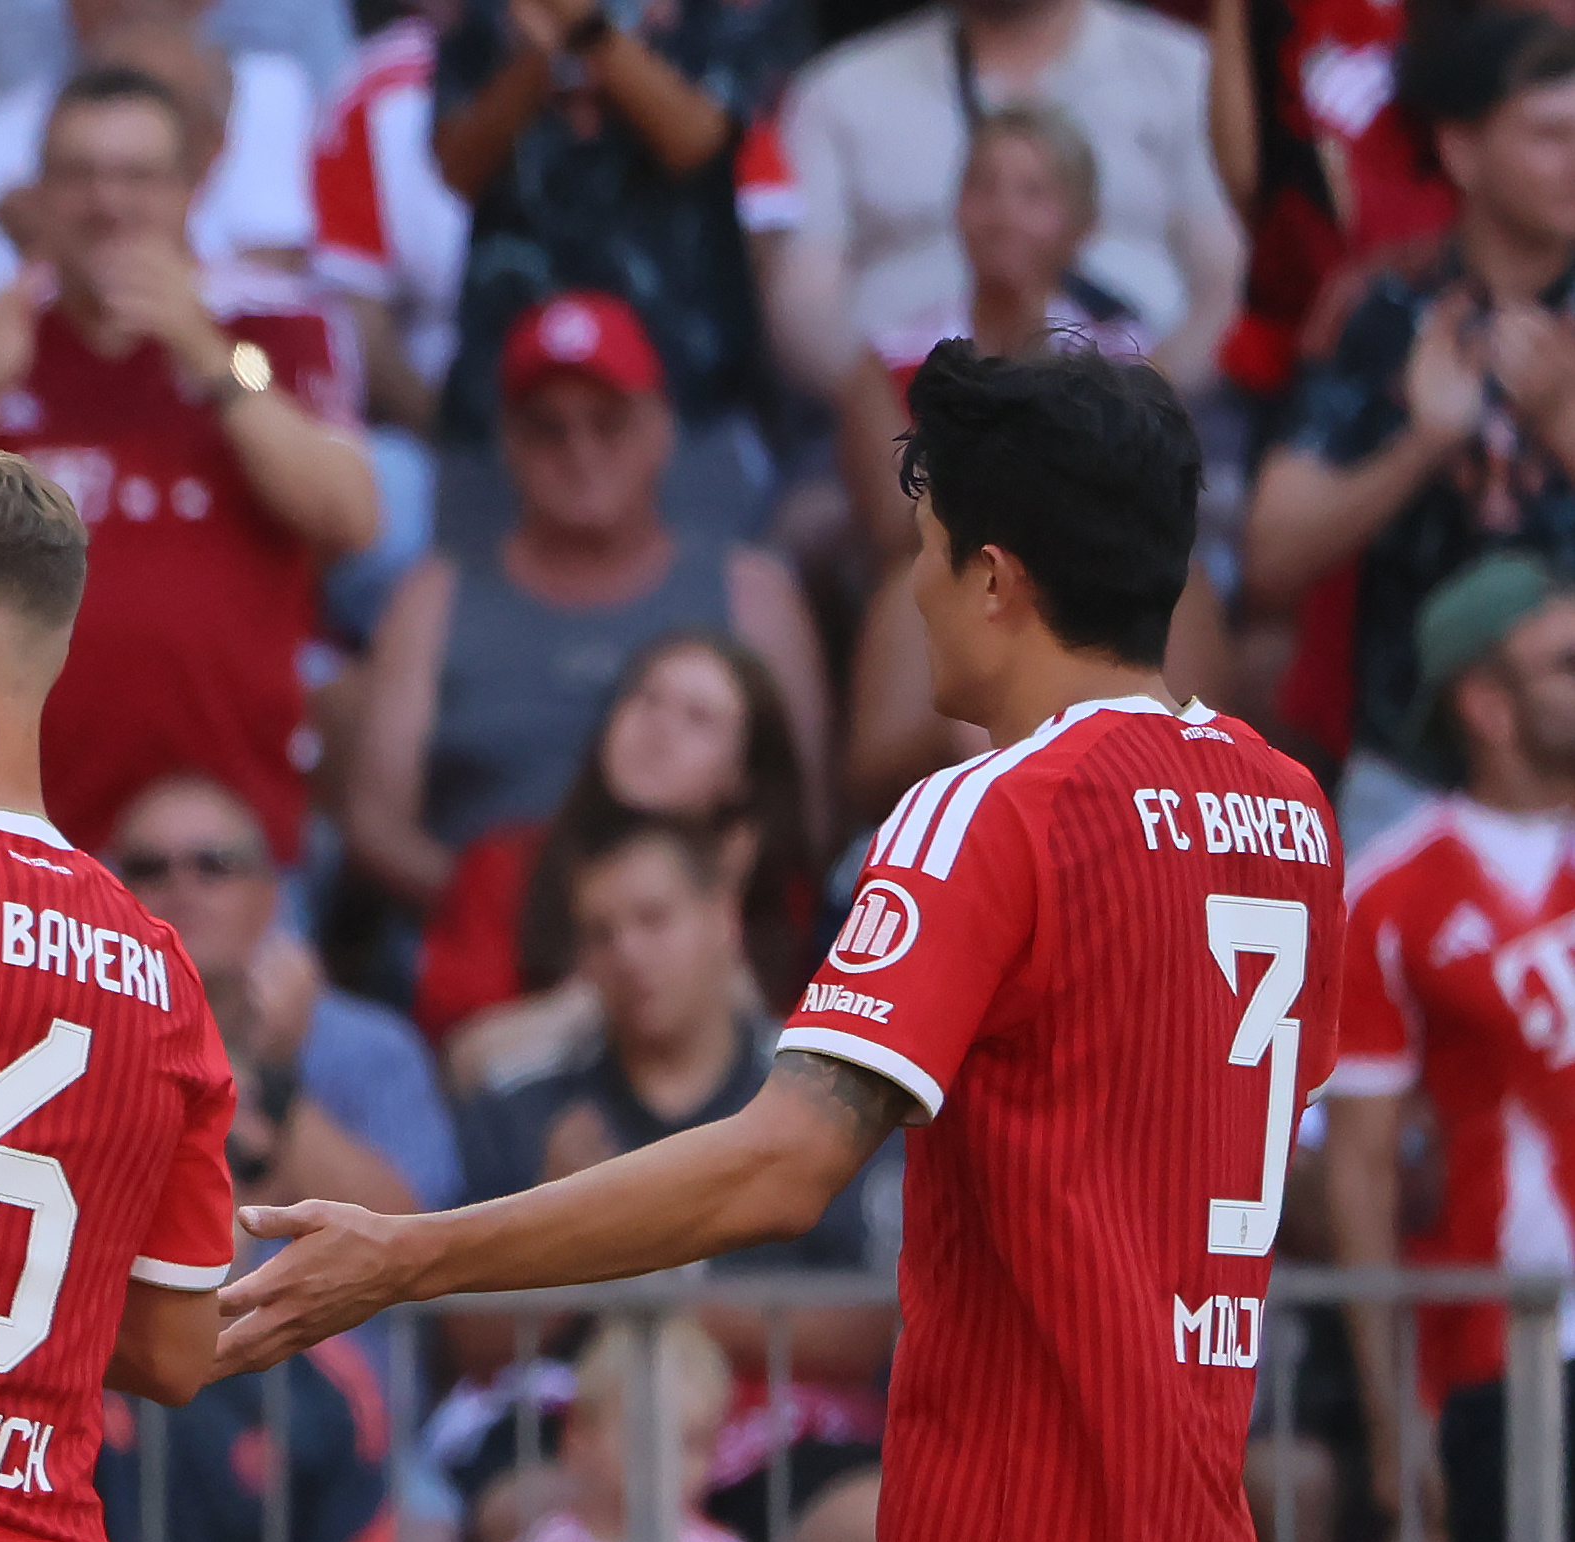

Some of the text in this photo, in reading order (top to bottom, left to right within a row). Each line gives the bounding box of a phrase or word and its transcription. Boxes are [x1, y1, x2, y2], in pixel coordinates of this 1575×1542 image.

[1133, 788, 1332, 868] FC BAYERN
[1, 901, 170, 1012] BAYERN
[800, 982, 895, 1025] Allianz
[1205, 893, 1309, 1257] 3
[1173, 1292, 1266, 1369] MINJ
